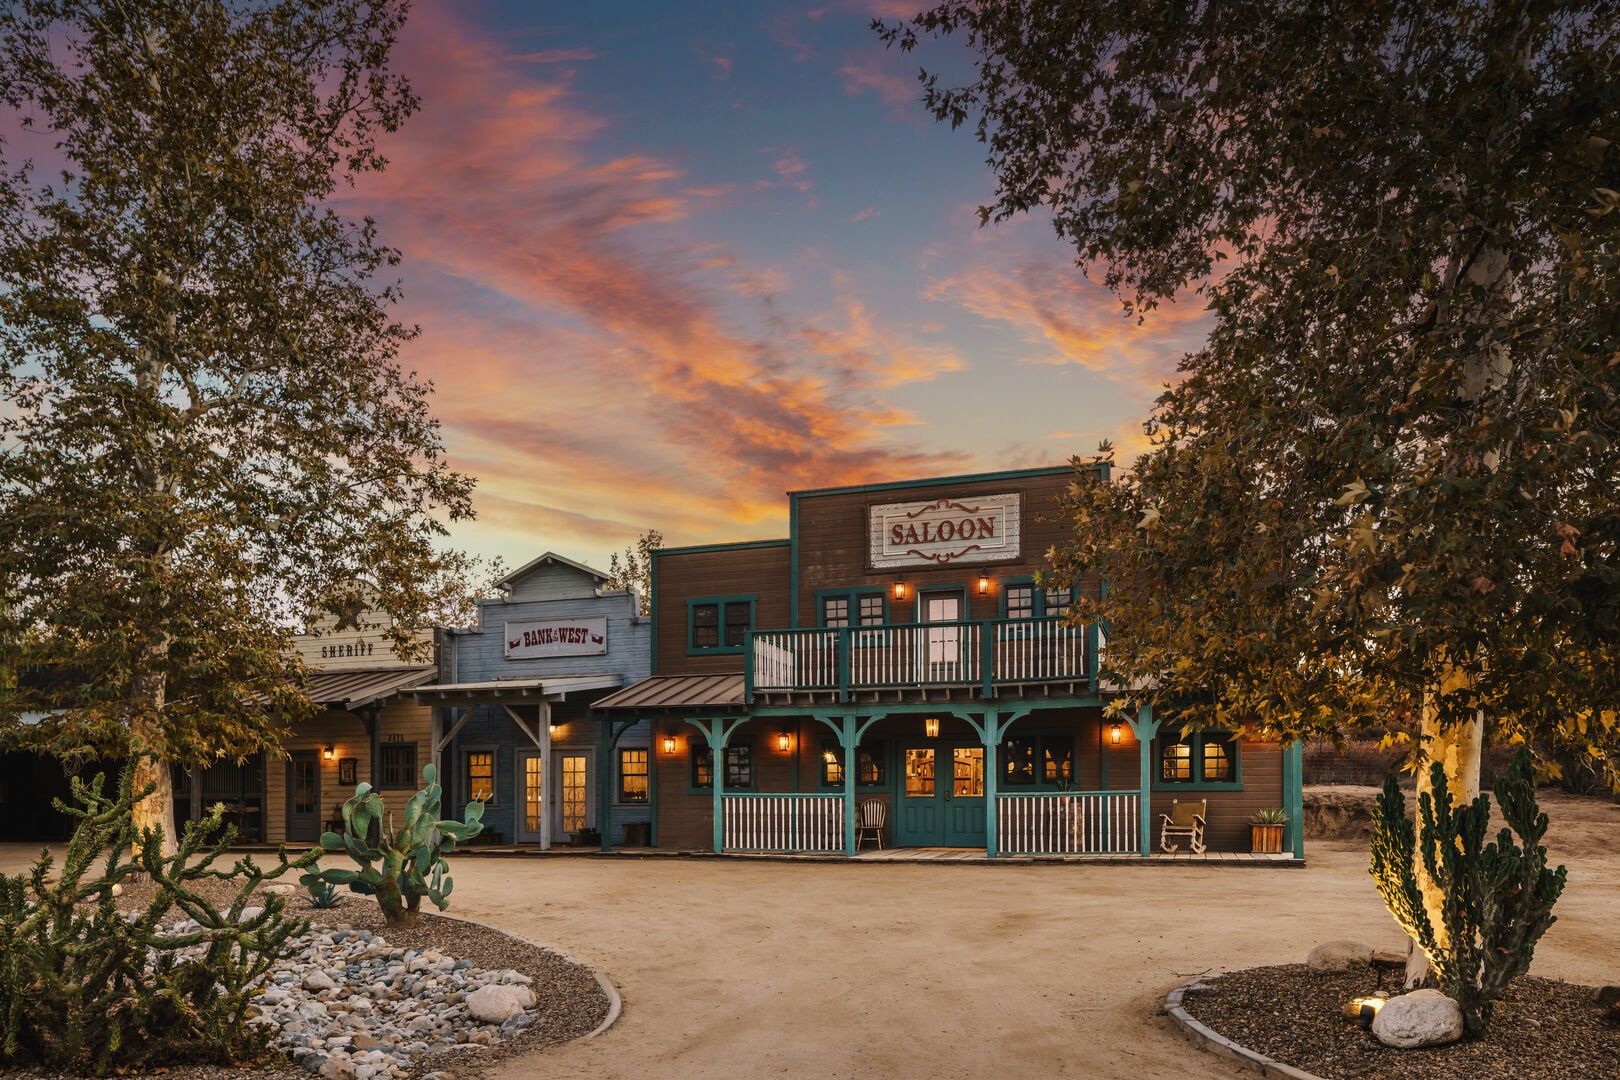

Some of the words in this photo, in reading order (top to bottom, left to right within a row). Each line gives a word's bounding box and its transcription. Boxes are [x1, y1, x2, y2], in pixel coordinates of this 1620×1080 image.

[891, 516, 996, 546] SALOON
[523, 627, 553, 647] BANK
[559, 627, 589, 644] WEST
[321, 643, 374, 659] SHERIFF
